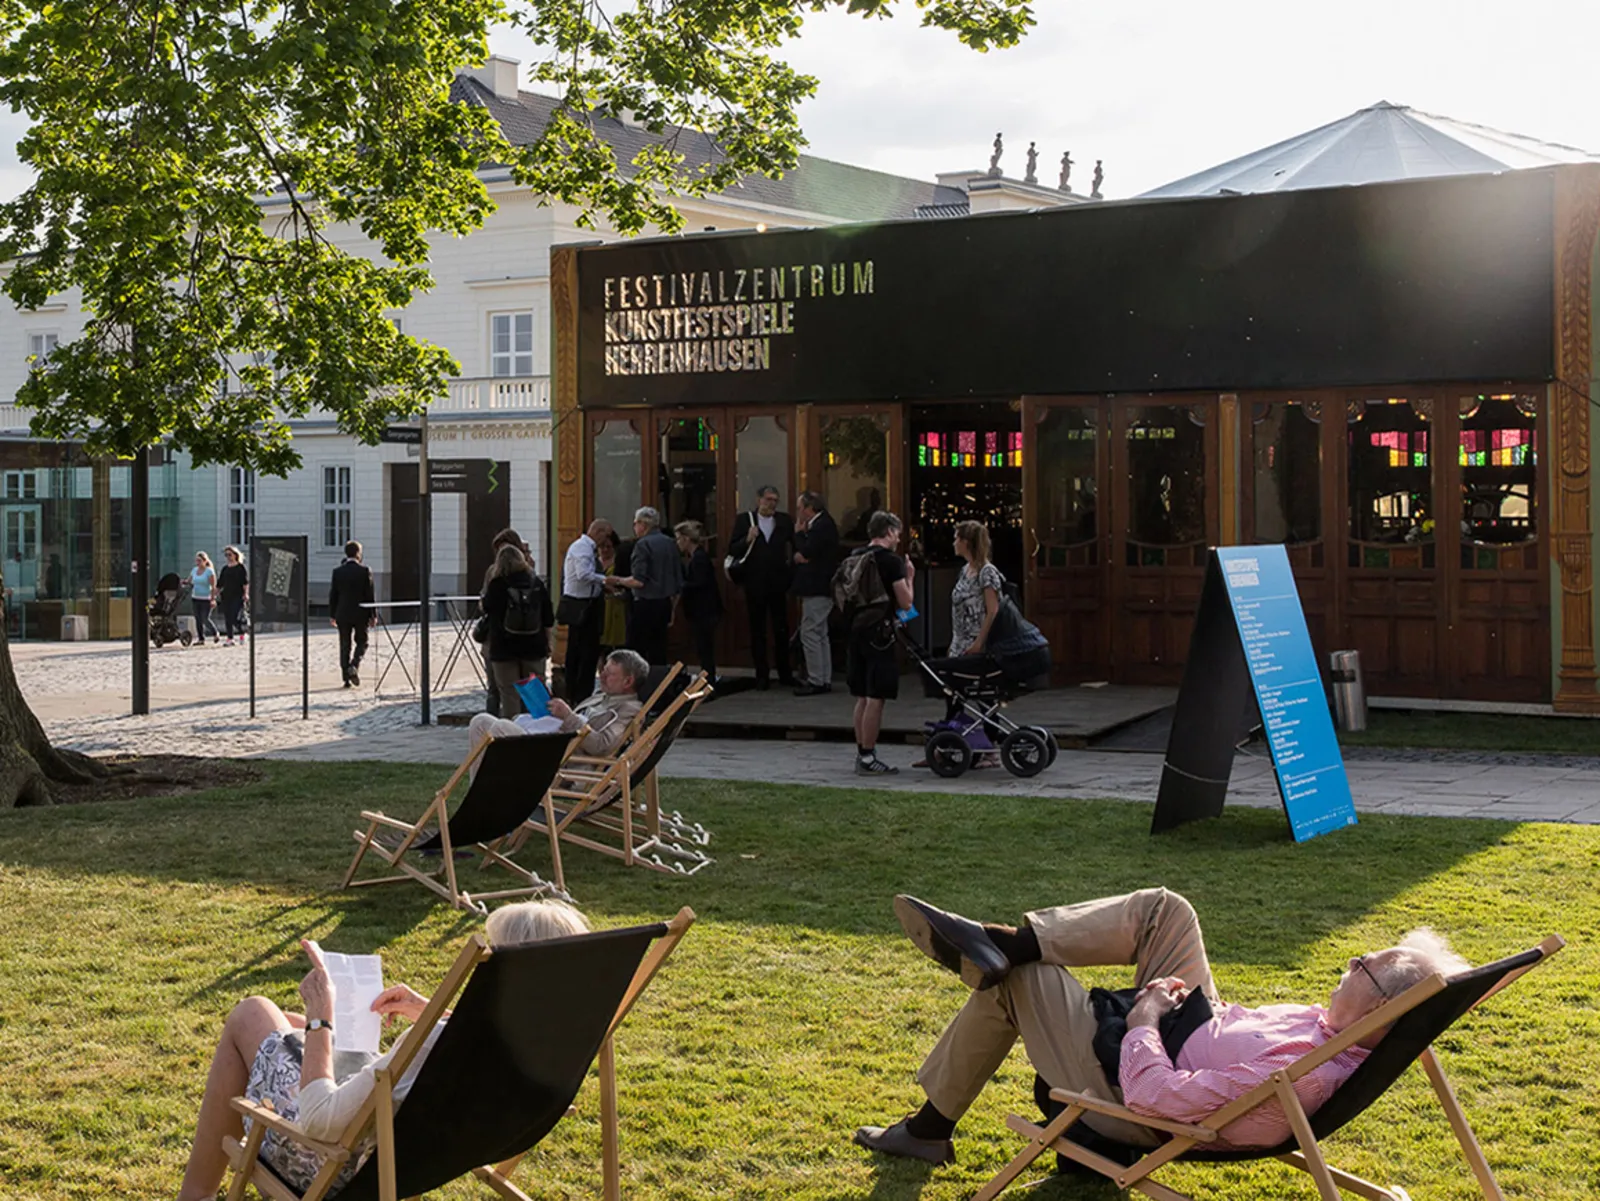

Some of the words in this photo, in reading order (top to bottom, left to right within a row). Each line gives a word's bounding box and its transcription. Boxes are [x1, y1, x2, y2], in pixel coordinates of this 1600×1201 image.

[605, 260, 874, 308] FESTIVALZENTRUM
[605, 302, 794, 342] KUNSTFESTSPIELE
[605, 338, 770, 376] HERRENHAUSEN
[426, 430, 457, 441] USEUM
[471, 430, 512, 440] GROSSER
